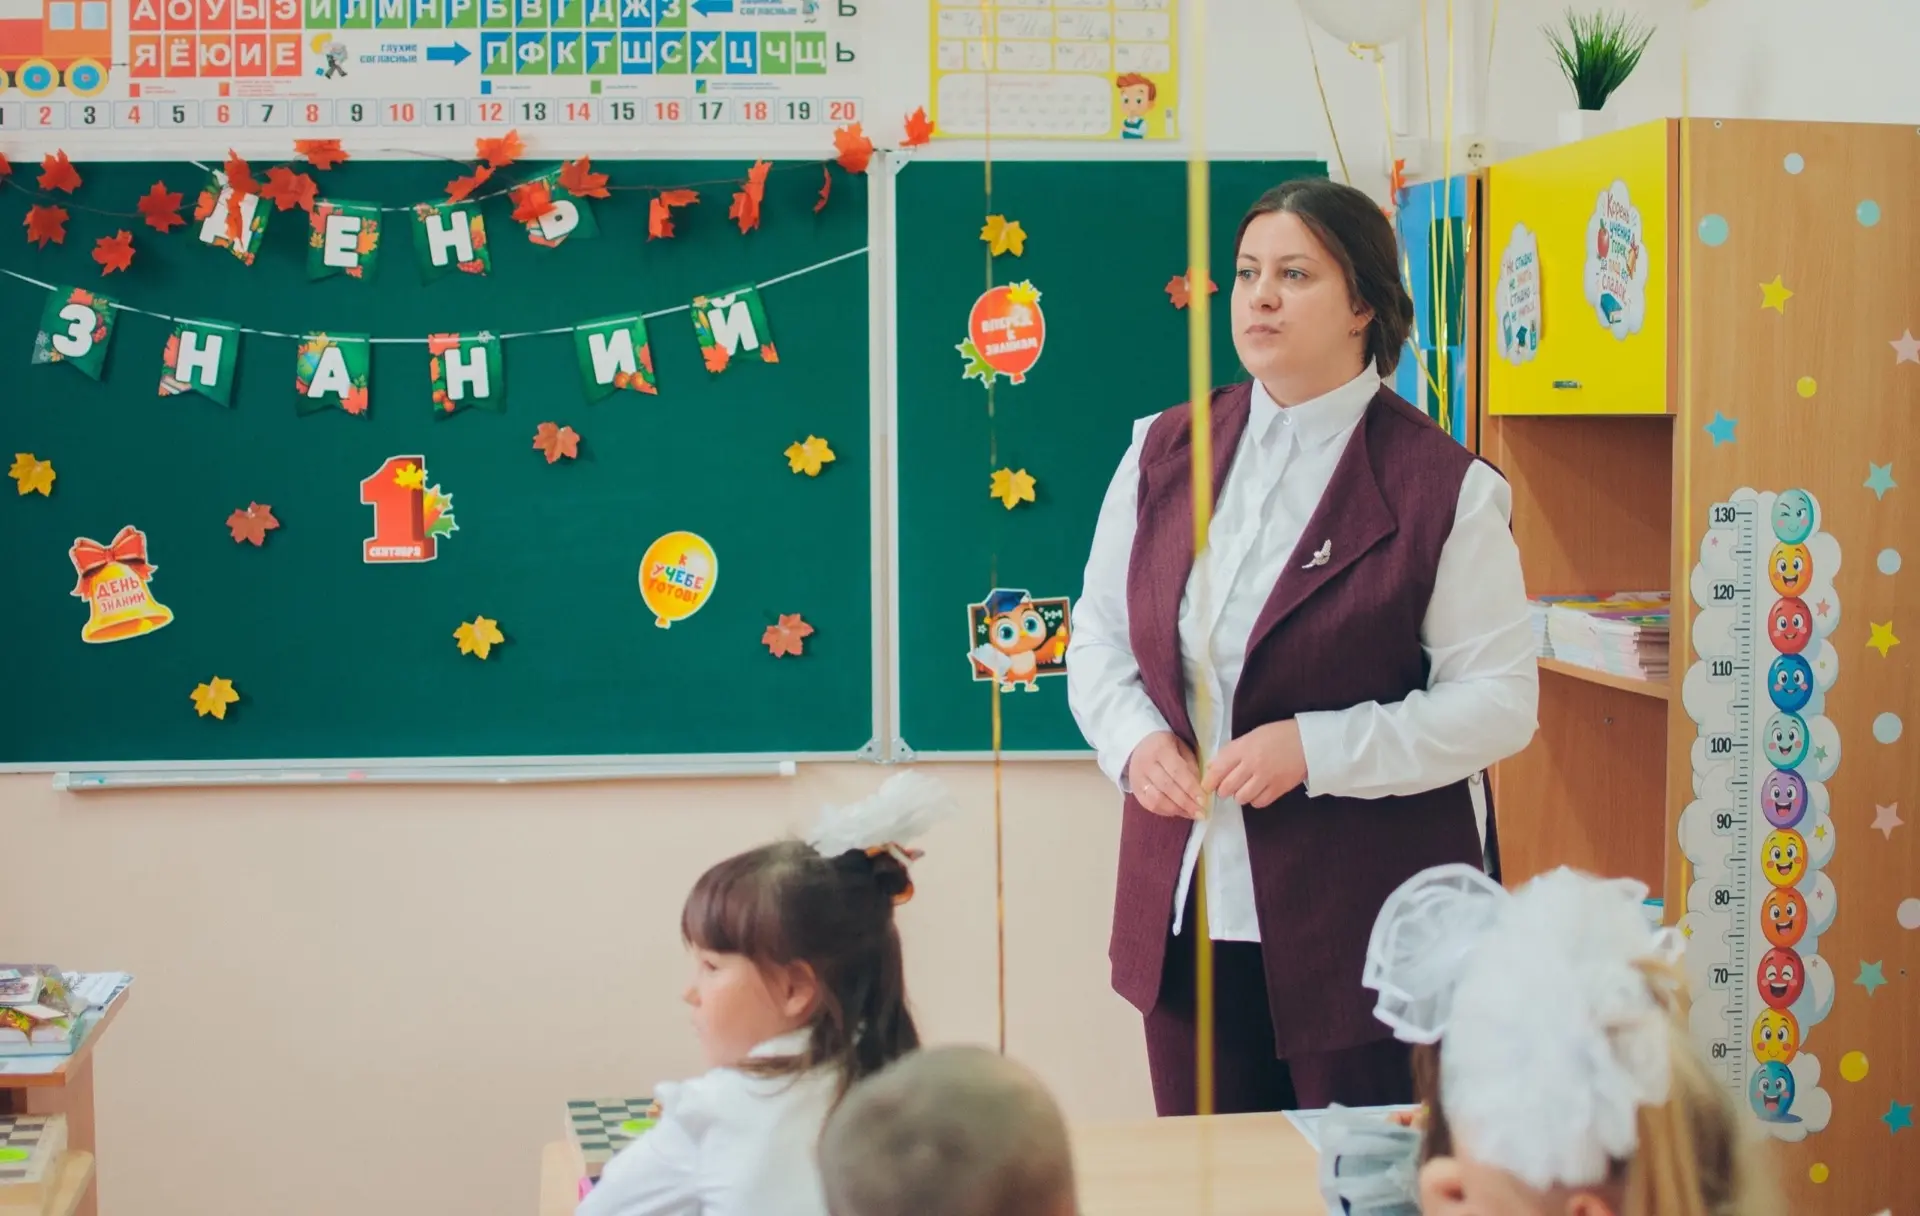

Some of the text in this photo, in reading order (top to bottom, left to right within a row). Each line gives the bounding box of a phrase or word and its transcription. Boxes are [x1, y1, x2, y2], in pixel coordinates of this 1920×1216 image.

[133, 0, 297, 21] А О У Ы Э
[345, 0, 367, 19] Л
[379, 0, 403, 19] М
[416, 0, 437, 19] Н
[452, 0, 471, 19] Р
[521, 0, 543, 19] В
[589, 0, 614, 22] Д
[622, 0, 650, 18] Ж
[662, 0, 681, 18] З
[135, 38, 296, 67] Я Ё Ю И Е
[360, 54, 417, 64] согласные
[487, 40, 826, 68] П Ф К Т Ш С Х Ц Ч Щ
[836, 42, 855, 62] Ь
[39, 106, 52, 125] 2
[84, 106, 96, 124] 3
[128, 105, 140, 124] 4
[172, 105, 185, 123] 5
[217, 104, 229, 123] 6
[261, 104, 274, 123] 7
[306, 104, 319, 123] 8
[351, 103, 363, 122] 9
[389, 103, 414, 122] 10
[433, 103, 455, 121] 11
[478, 103, 502, 121] 12
[521, 102, 546, 121] 13
[566, 102, 591, 121] 14
[610, 102, 635, 120] 15
[655, 102, 680, 120] 16
[699, 101, 723, 120] 17
[744, 102, 767, 120] 18
[787, 102, 810, 120] 19
[830, 102, 856, 120] 20
[1607, 193, 1630, 224] Корень
[53, 293, 758, 400] ЗНАНИЙ
[361, 455, 437, 562] 1
[1714, 507, 1736, 522] 130
[679, 553, 687, 566] К
[652, 563, 704, 590] УЧЕБЕ
[97, 576, 140, 599] ДЕНЬ
[647, 577, 699, 605] ГОТОВ!
[1713, 584, 1735, 600] 120
[1711, 660, 1733, 676] 110
[1710, 737, 1732, 753] 100
[1716, 814, 1732, 829] 90
[1714, 890, 1730, 905] 80
[1713, 968, 1729, 984] 70
[1711, 1043, 1727, 1058] 60
